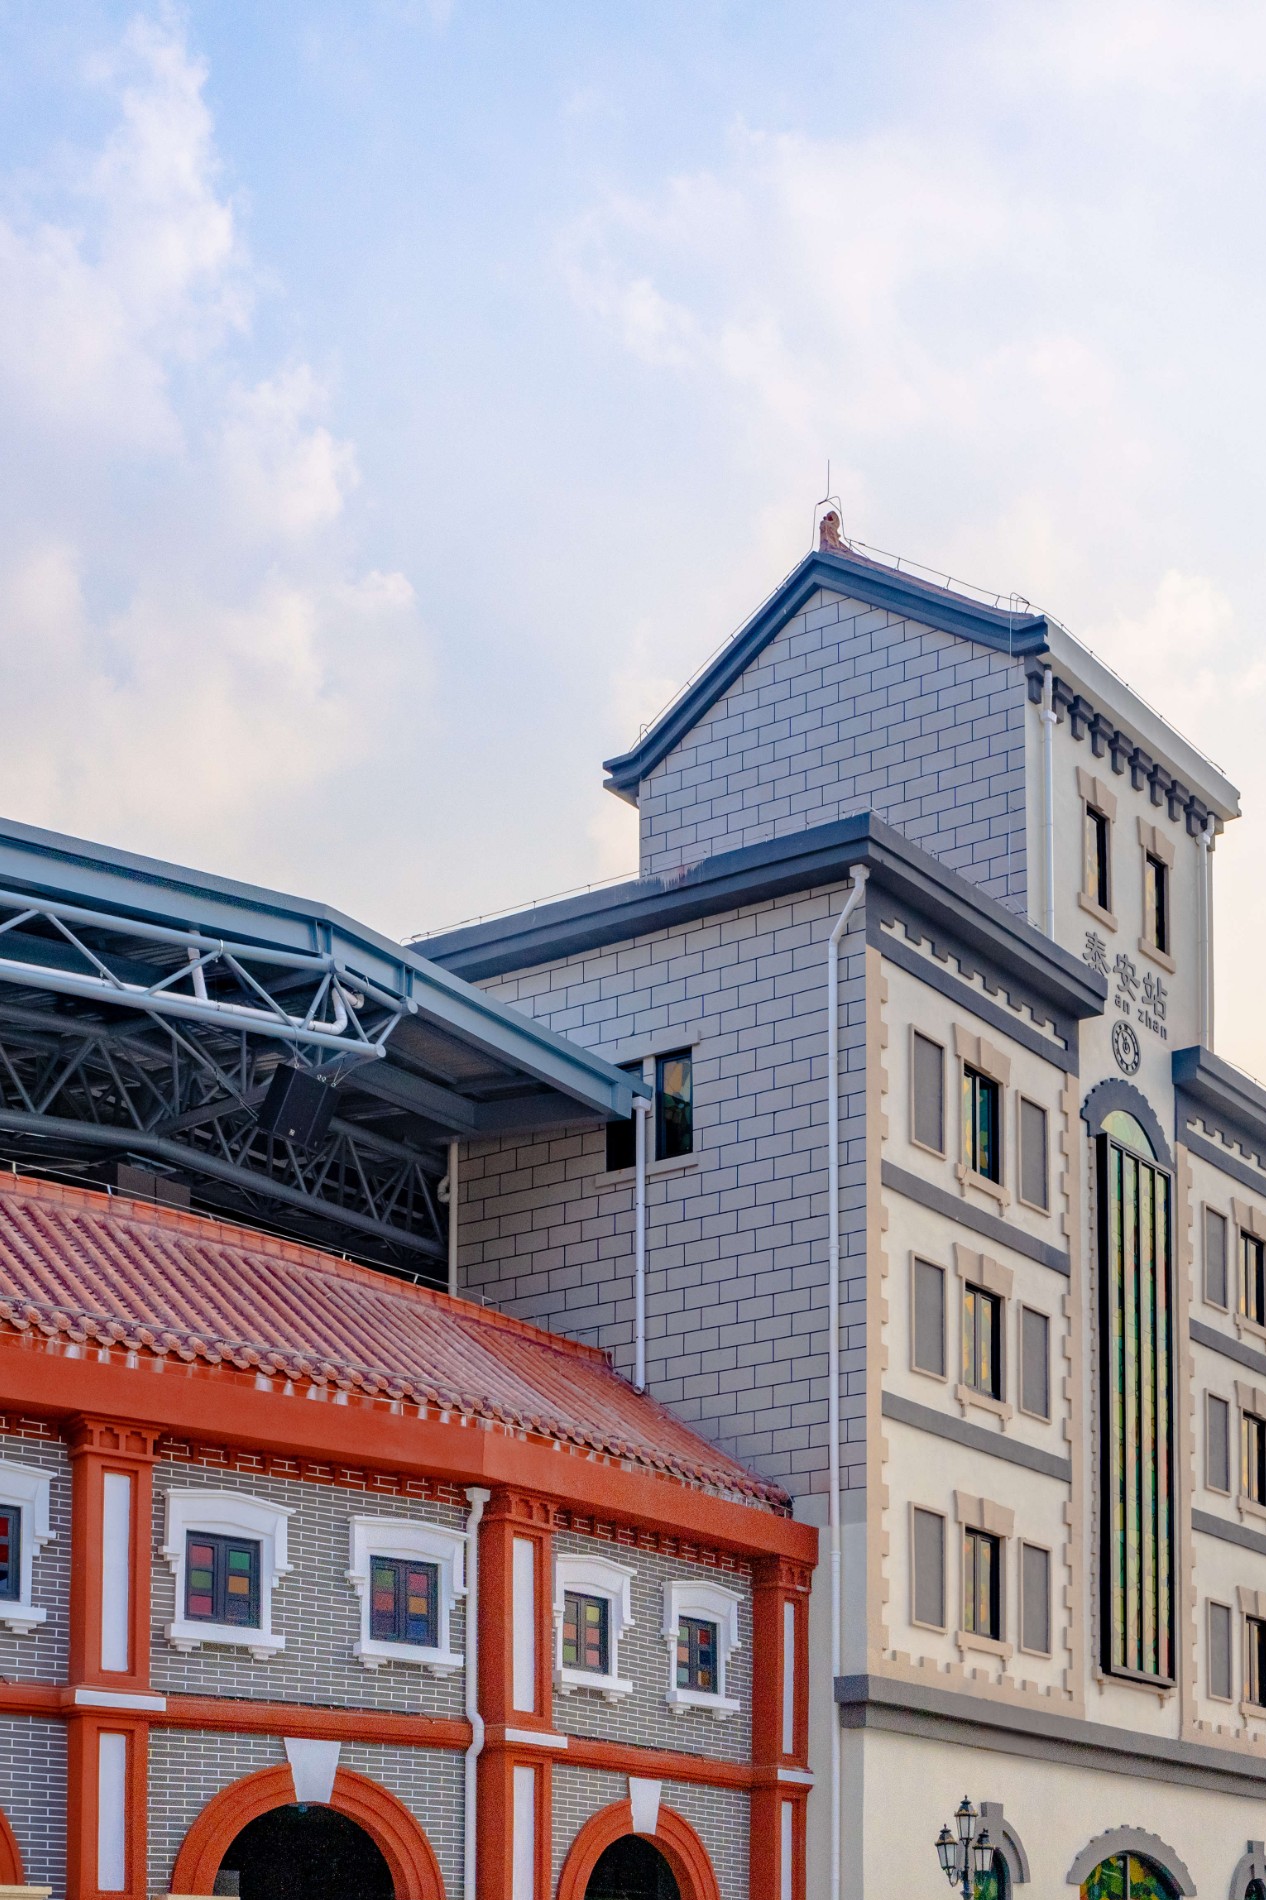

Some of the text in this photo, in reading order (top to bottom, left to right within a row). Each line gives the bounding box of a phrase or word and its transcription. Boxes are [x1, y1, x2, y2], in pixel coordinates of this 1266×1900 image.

[1082, 931, 1168, 1021] 泰安站
[1137, 1008, 1167, 1040] zhan
